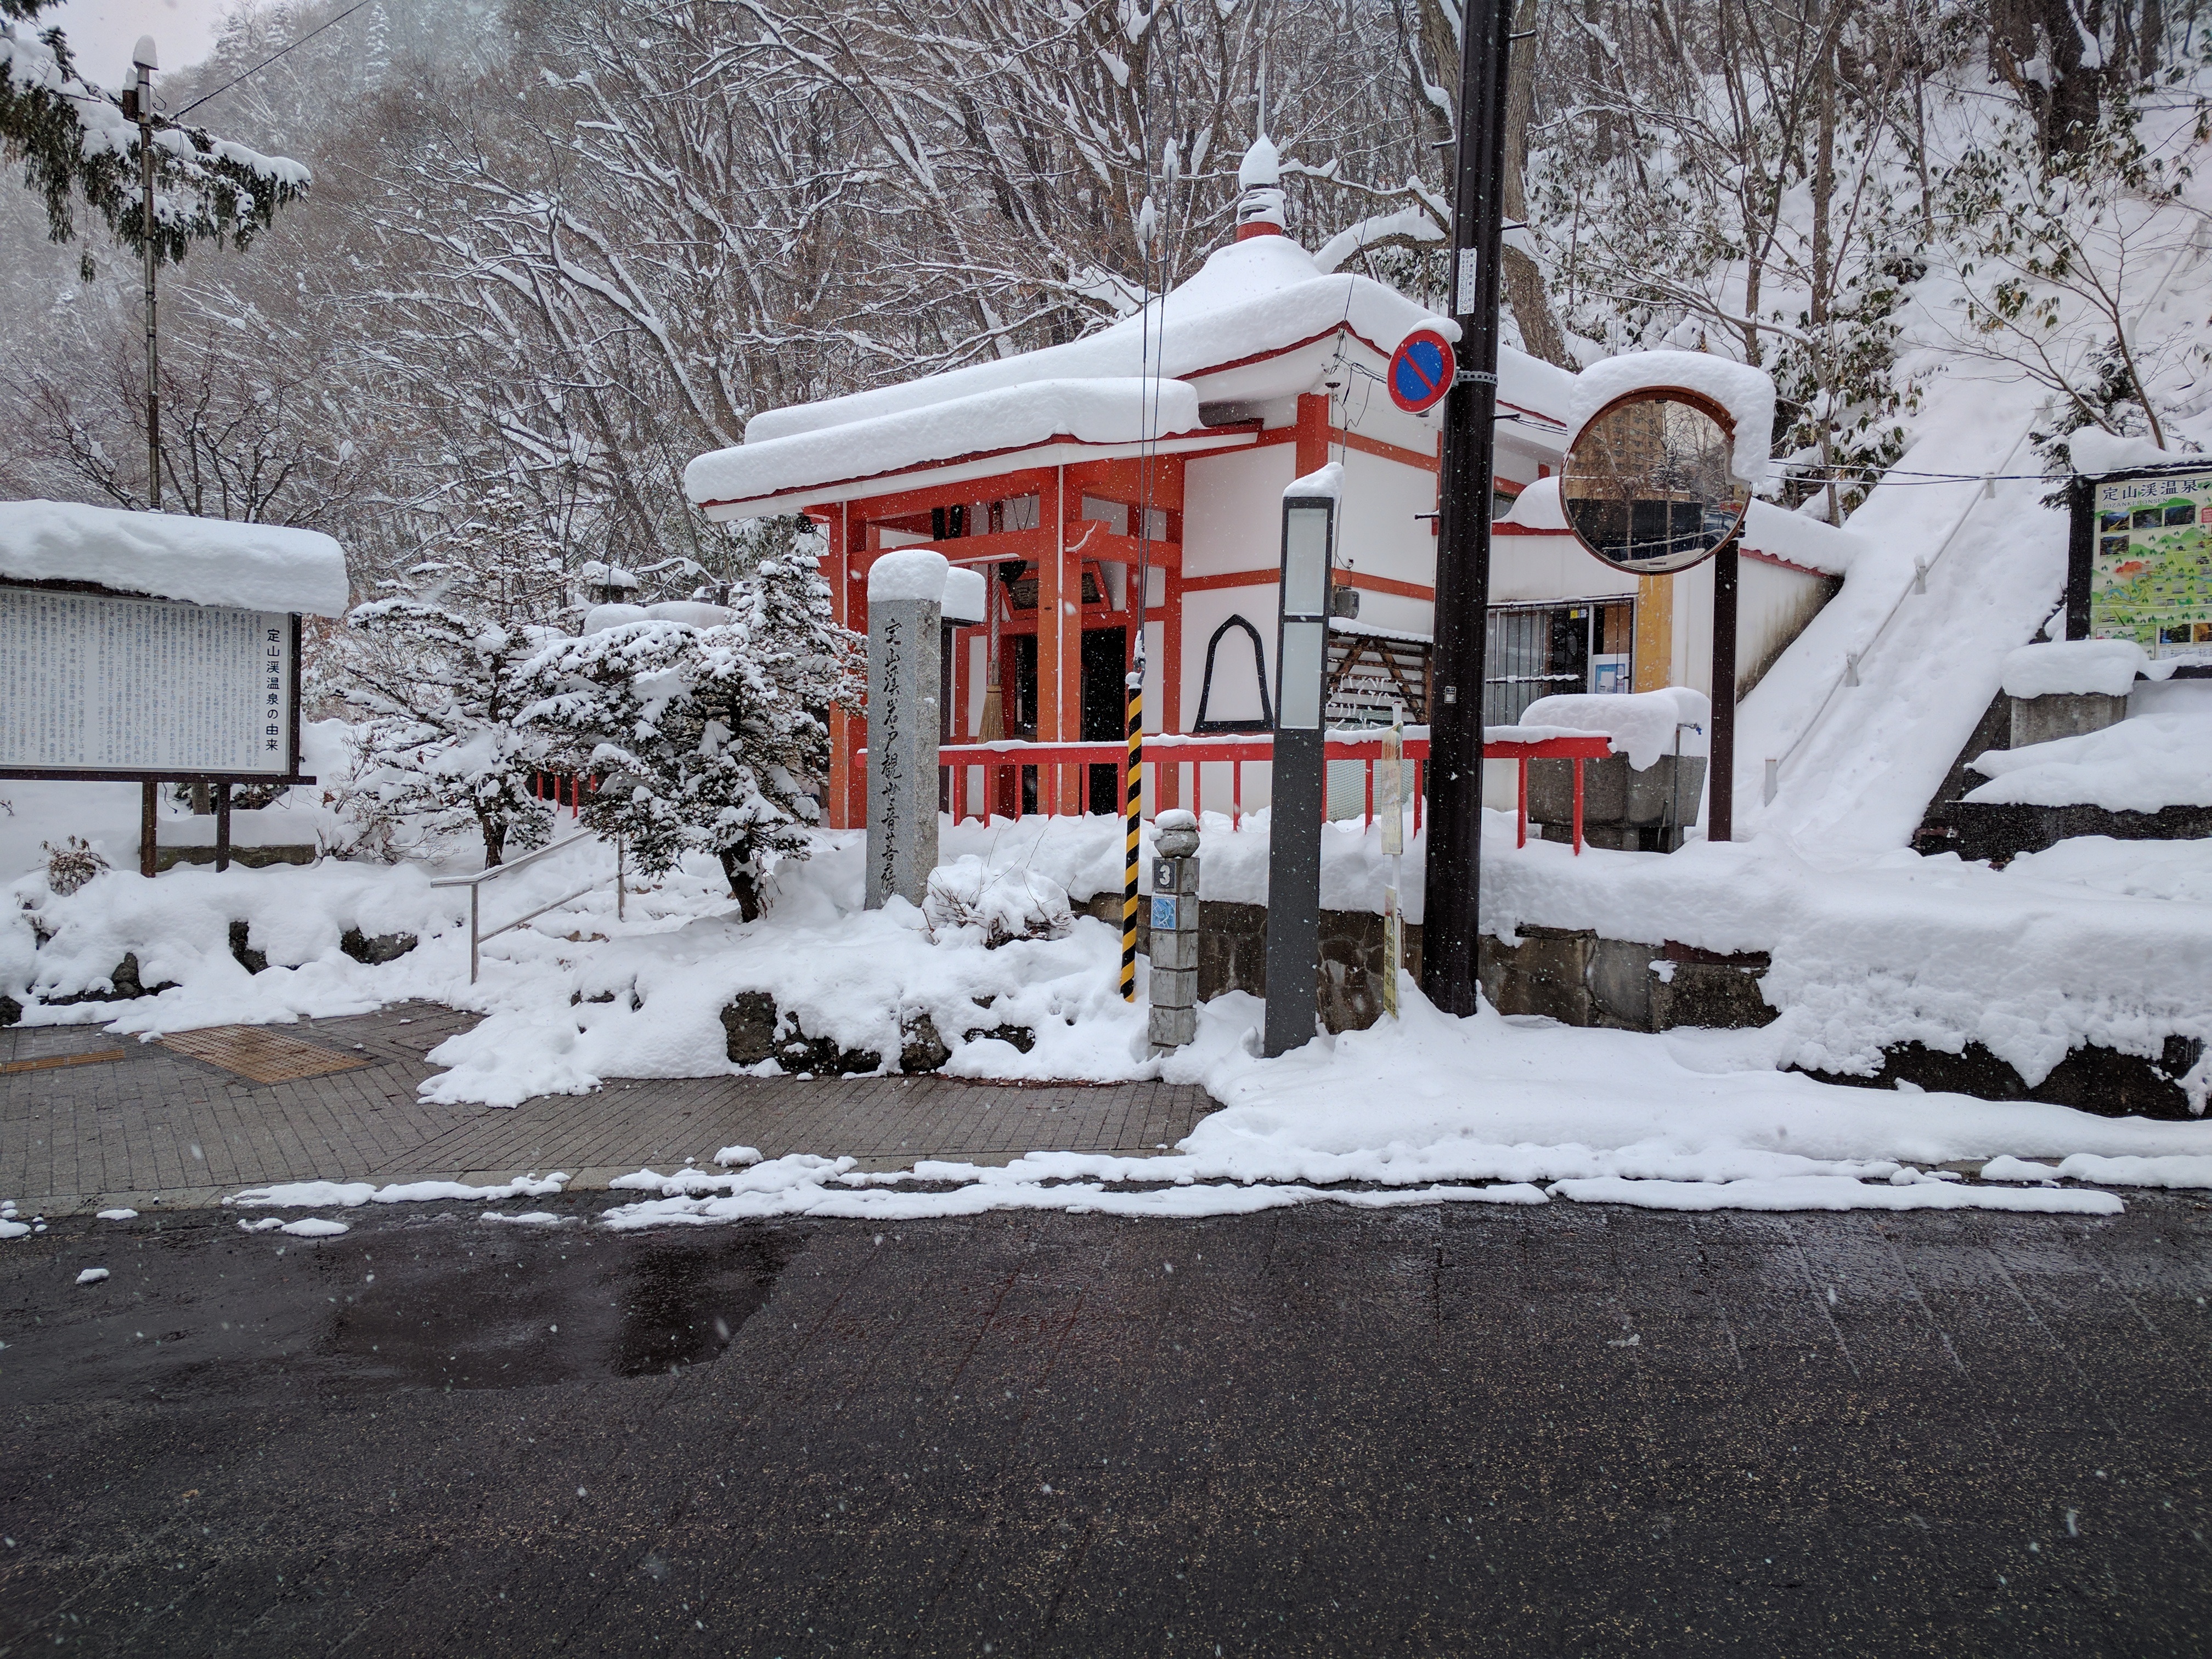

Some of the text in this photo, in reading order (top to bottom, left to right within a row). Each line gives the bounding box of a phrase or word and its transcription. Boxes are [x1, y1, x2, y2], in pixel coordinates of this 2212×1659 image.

[2102, 478, 2199, 502] 定山渓温泉
[2102, 501, 2139, 510] JOZANKEI
[266, 628, 280, 751] 定山渓温泉の由来
[1159, 865, 1170, 885] 3
